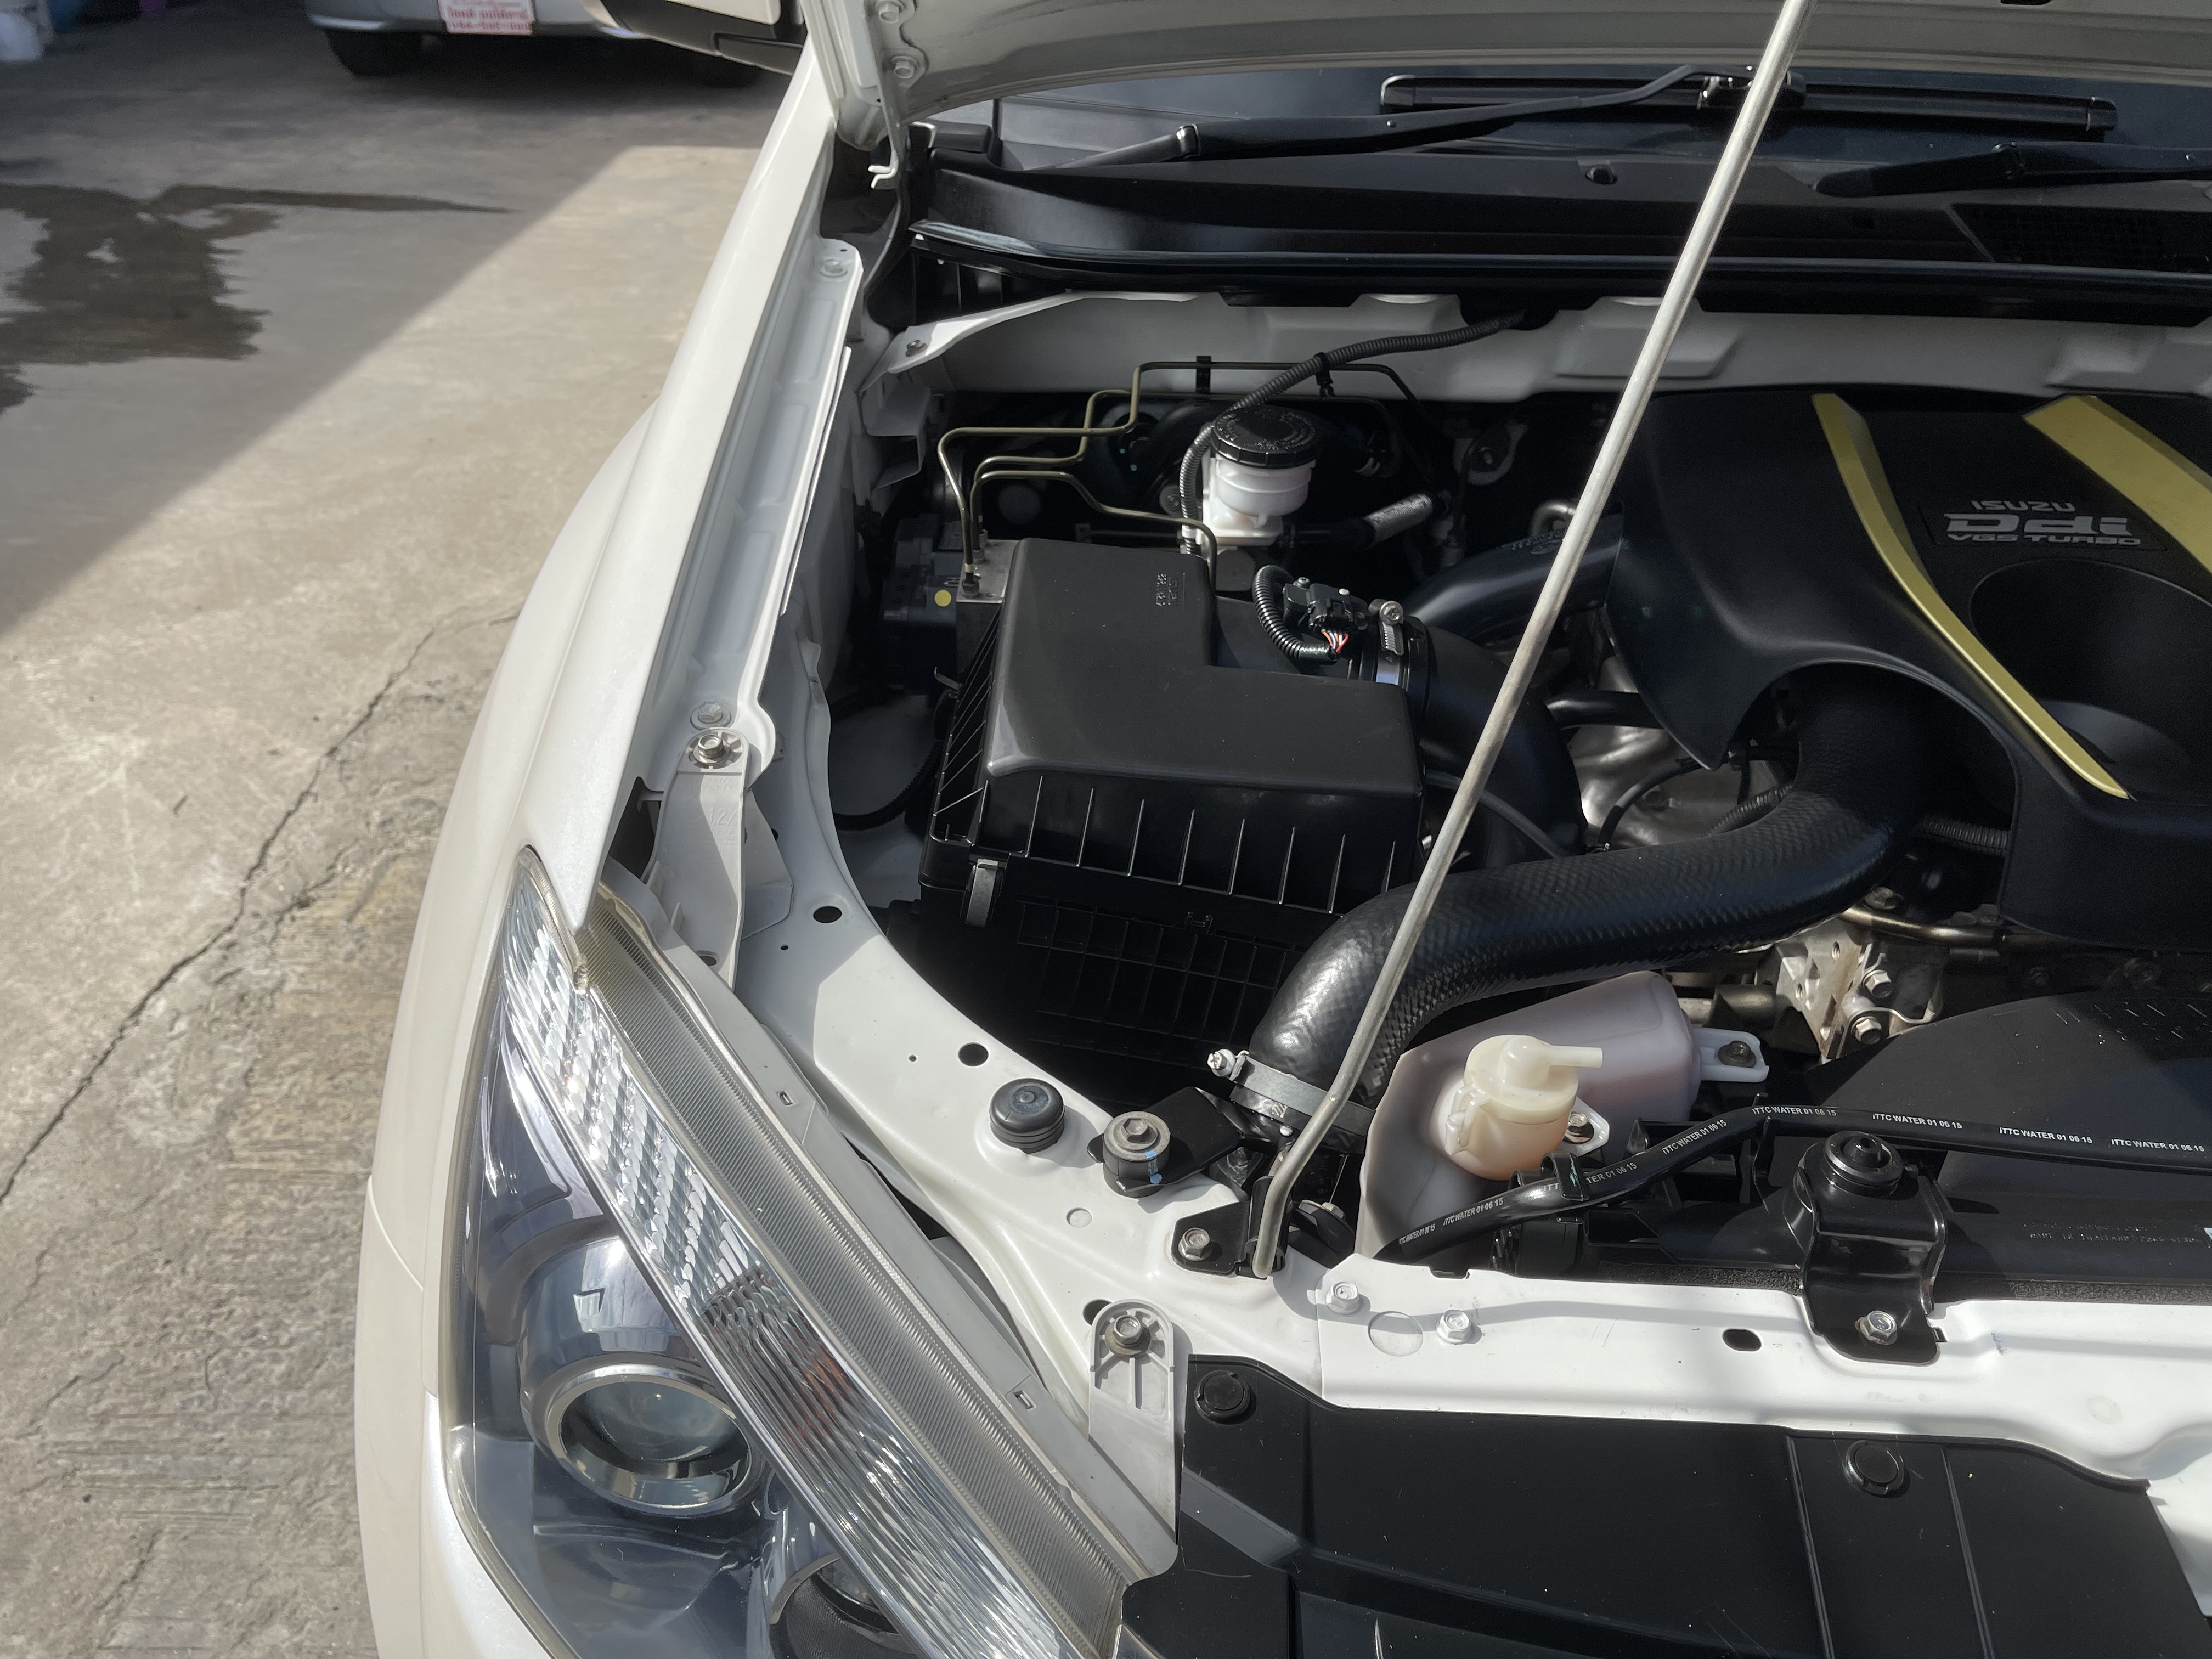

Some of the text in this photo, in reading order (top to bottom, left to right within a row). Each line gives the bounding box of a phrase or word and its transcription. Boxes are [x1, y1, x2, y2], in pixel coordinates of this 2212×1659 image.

[1971, 500, 2076, 512] ISUZU
[1948, 534, 2141, 545] VGS TURBO
[1752, 1107, 1771, 1115] ITTC
[1892, 1115, 1926, 1125] WATER
[1662, 1143, 1678, 1155] ITTC
[1676, 1131, 1703, 1147] WATER
[1708, 1123, 1718, 1131] 06
[1717, 1119, 1727, 1127] 15
[1999, 1127, 2020, 1136] ITTC
[2020, 1130, 2056, 1140] WATER
[2111, 1138, 2132, 1147] ITTC
[2132, 1141, 2168, 1149] WATER
[1585, 1173, 1606, 1184] TER
[1605, 1170, 1616, 1178] 01
[1616, 1166, 1627, 1175] 06
[1627, 1162, 1637, 1170] 15
[1443, 1198, 1504, 1226] ITTC WATER 01 06 15
[1430, 1223, 1436, 1232] 15
